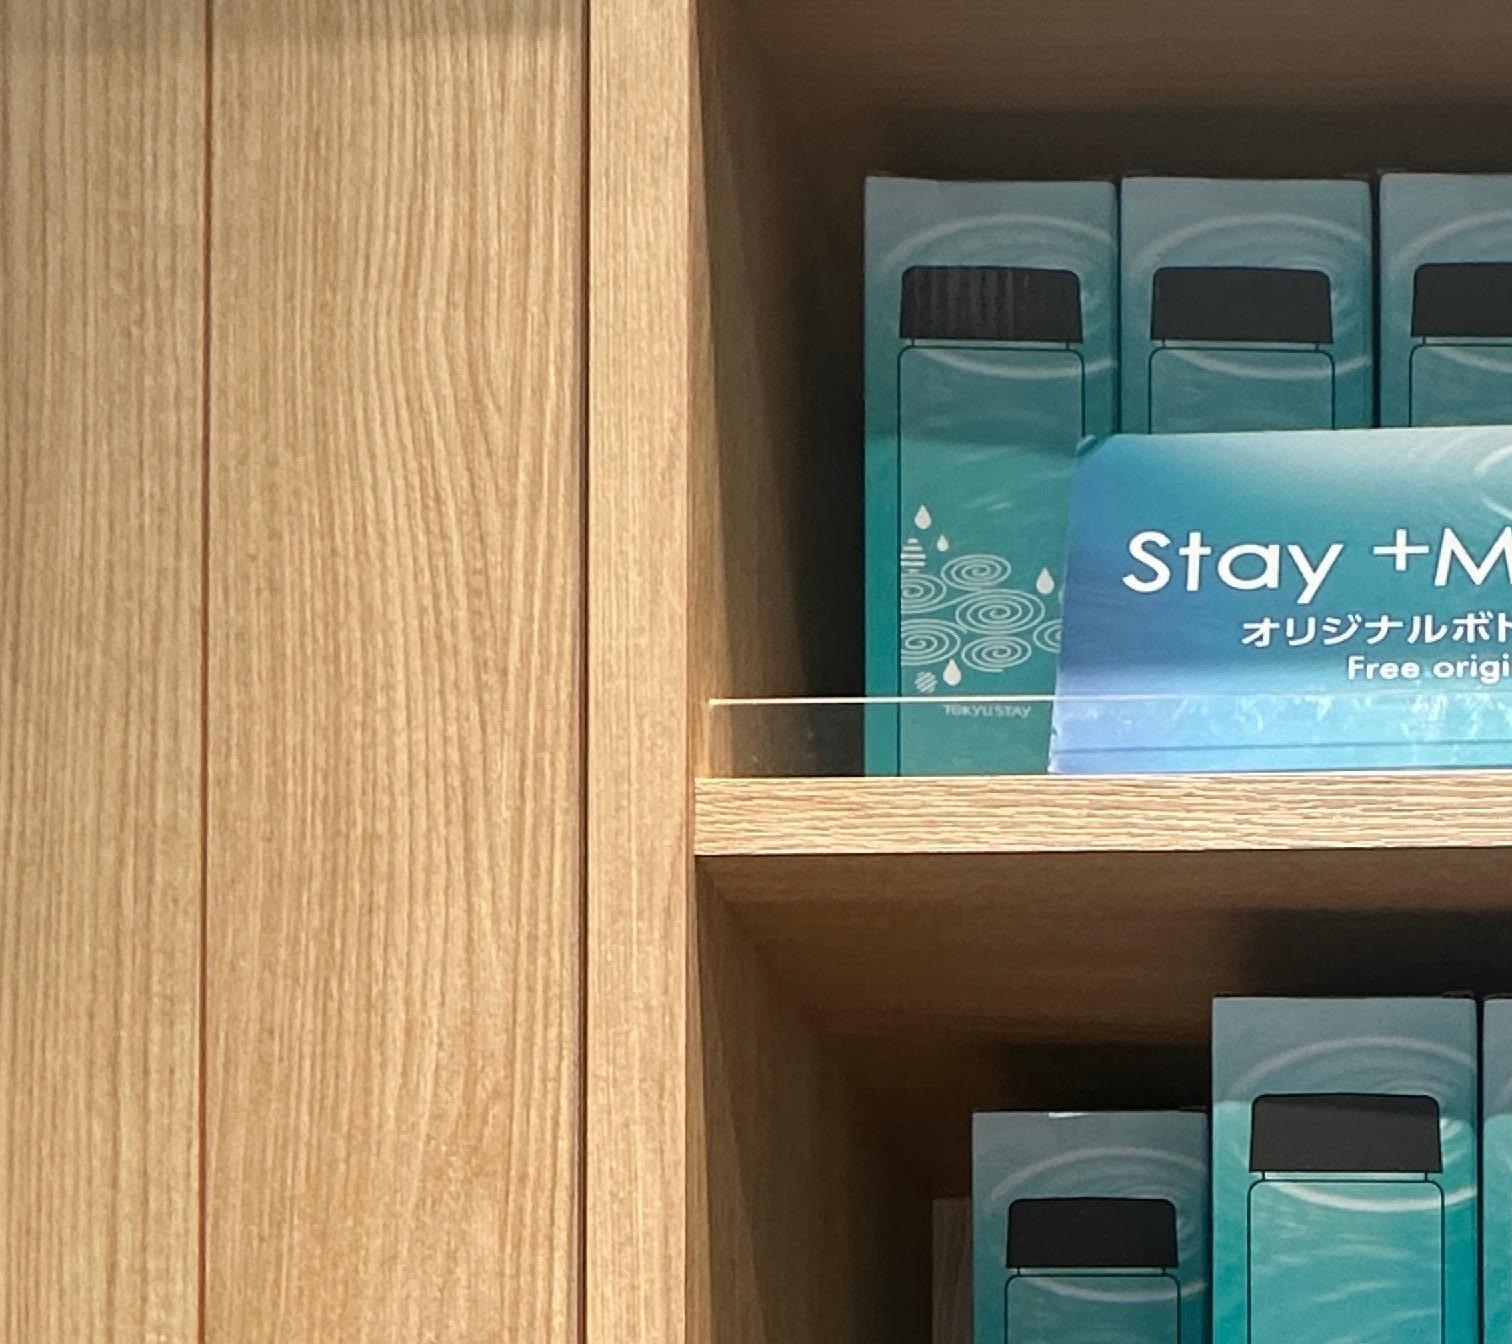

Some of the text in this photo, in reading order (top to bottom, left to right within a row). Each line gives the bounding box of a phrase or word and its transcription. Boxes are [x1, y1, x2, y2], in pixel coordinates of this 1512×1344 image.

[1122, 528, 1343, 604] Stay
[1347, 652, 1422, 681] Free
[943, 704, 1032, 718] TOKYU STAY
